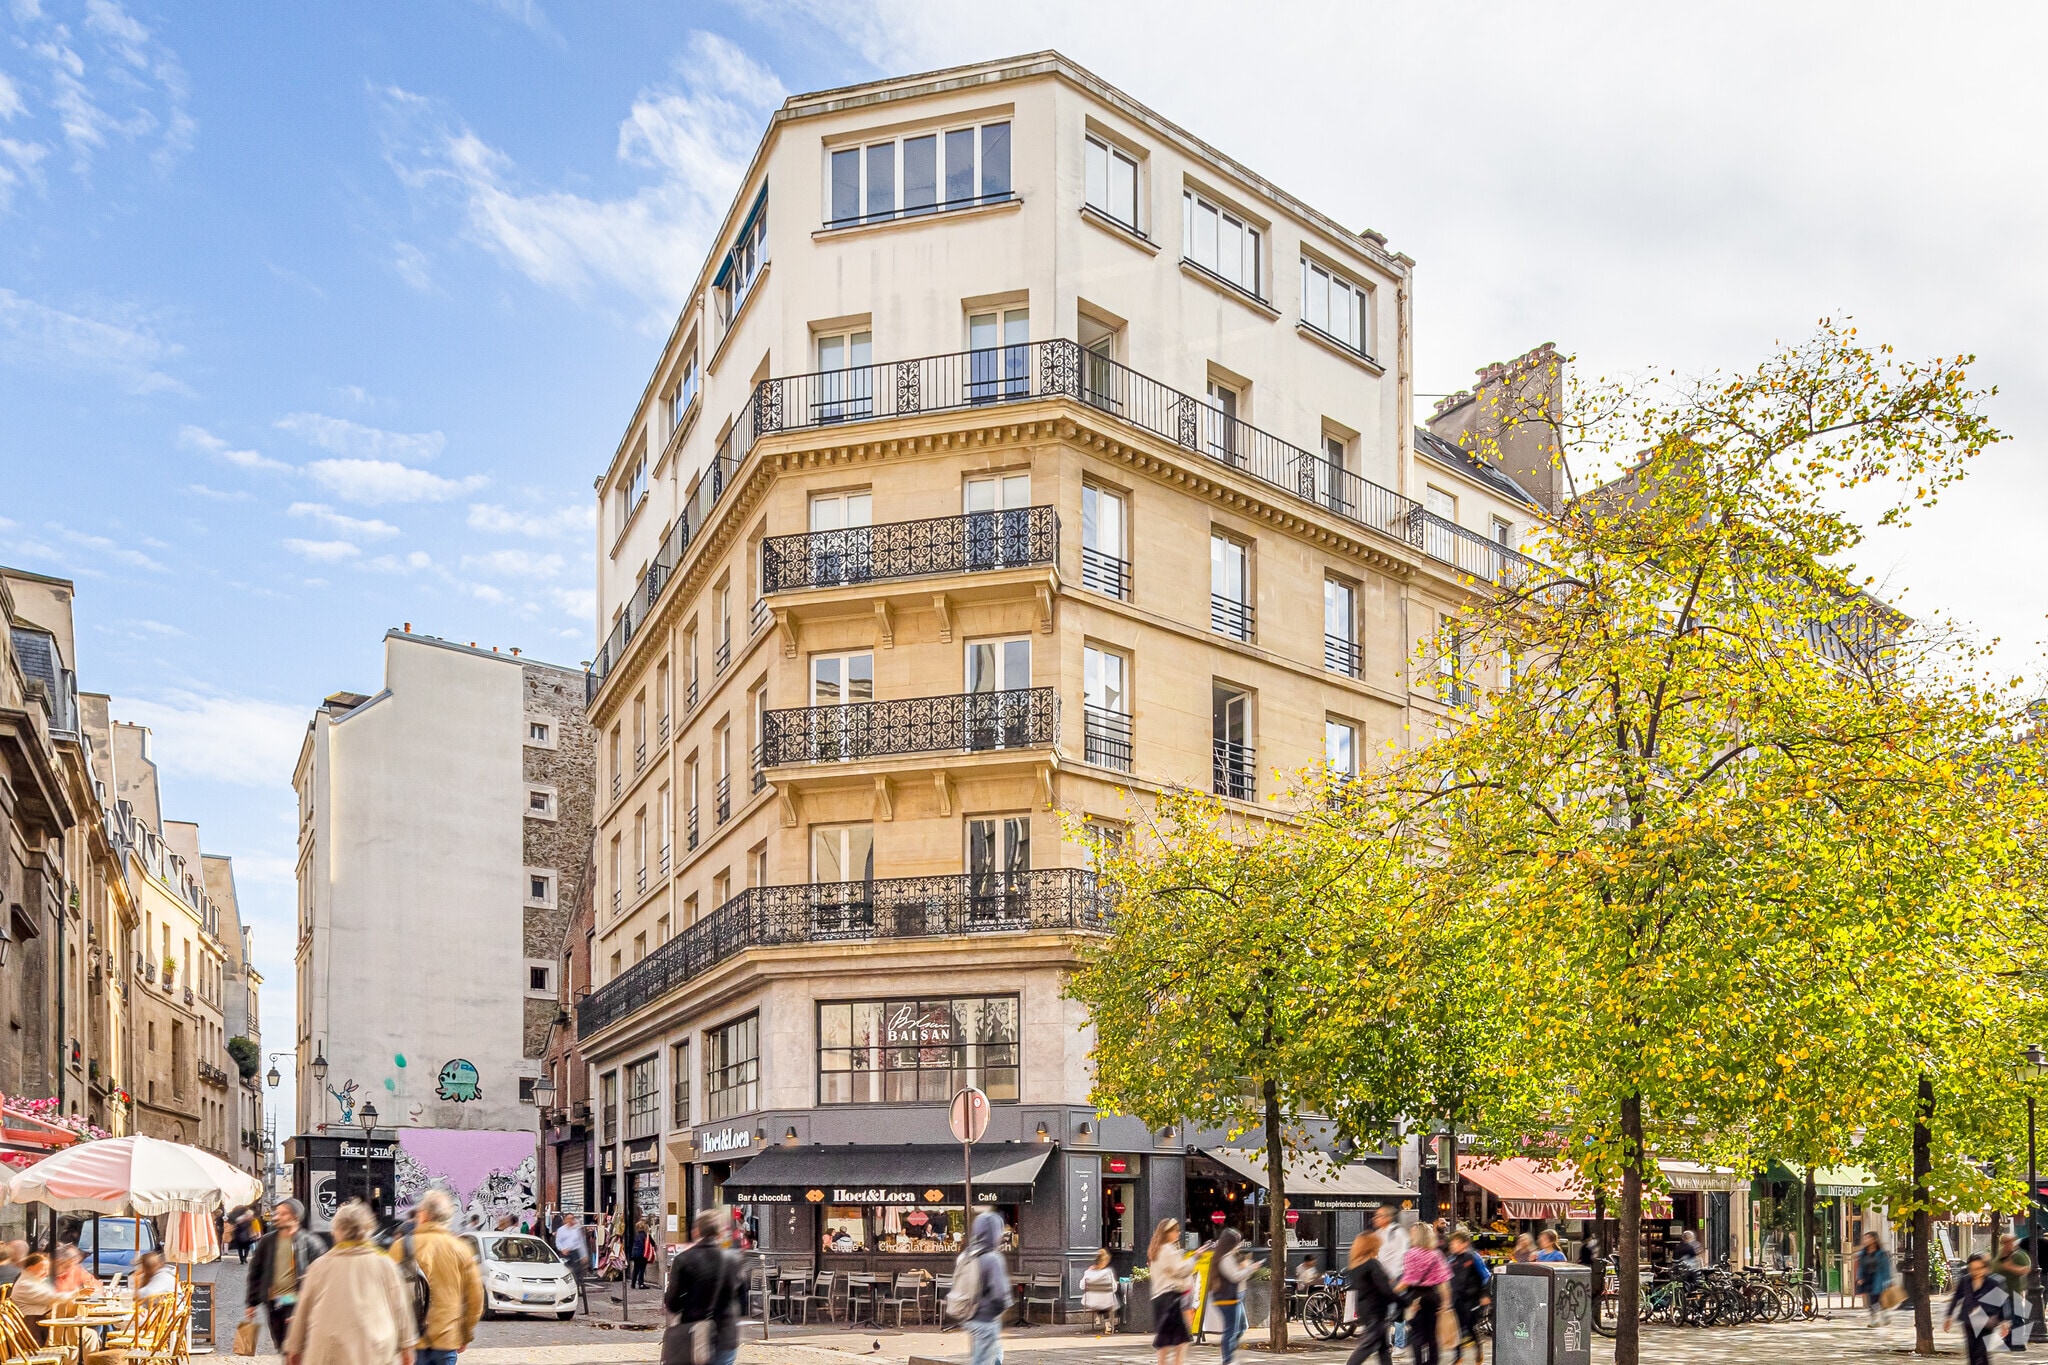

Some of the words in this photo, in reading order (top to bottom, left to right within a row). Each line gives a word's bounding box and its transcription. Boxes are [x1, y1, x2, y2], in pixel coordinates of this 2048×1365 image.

[889, 1029, 950, 1041] BALSAN
[738, 1193, 752, 1202] Bar
[752, 1193, 758, 1202] à
[758, 1193, 793, 1202] chocolat
[978, 1192, 998, 1202] Café
[1314, 1200, 1326, 1208] Mes
[1356, 1200, 1381, 1208] chocolats
[1298, 1238, 1319, 1247] chaud
